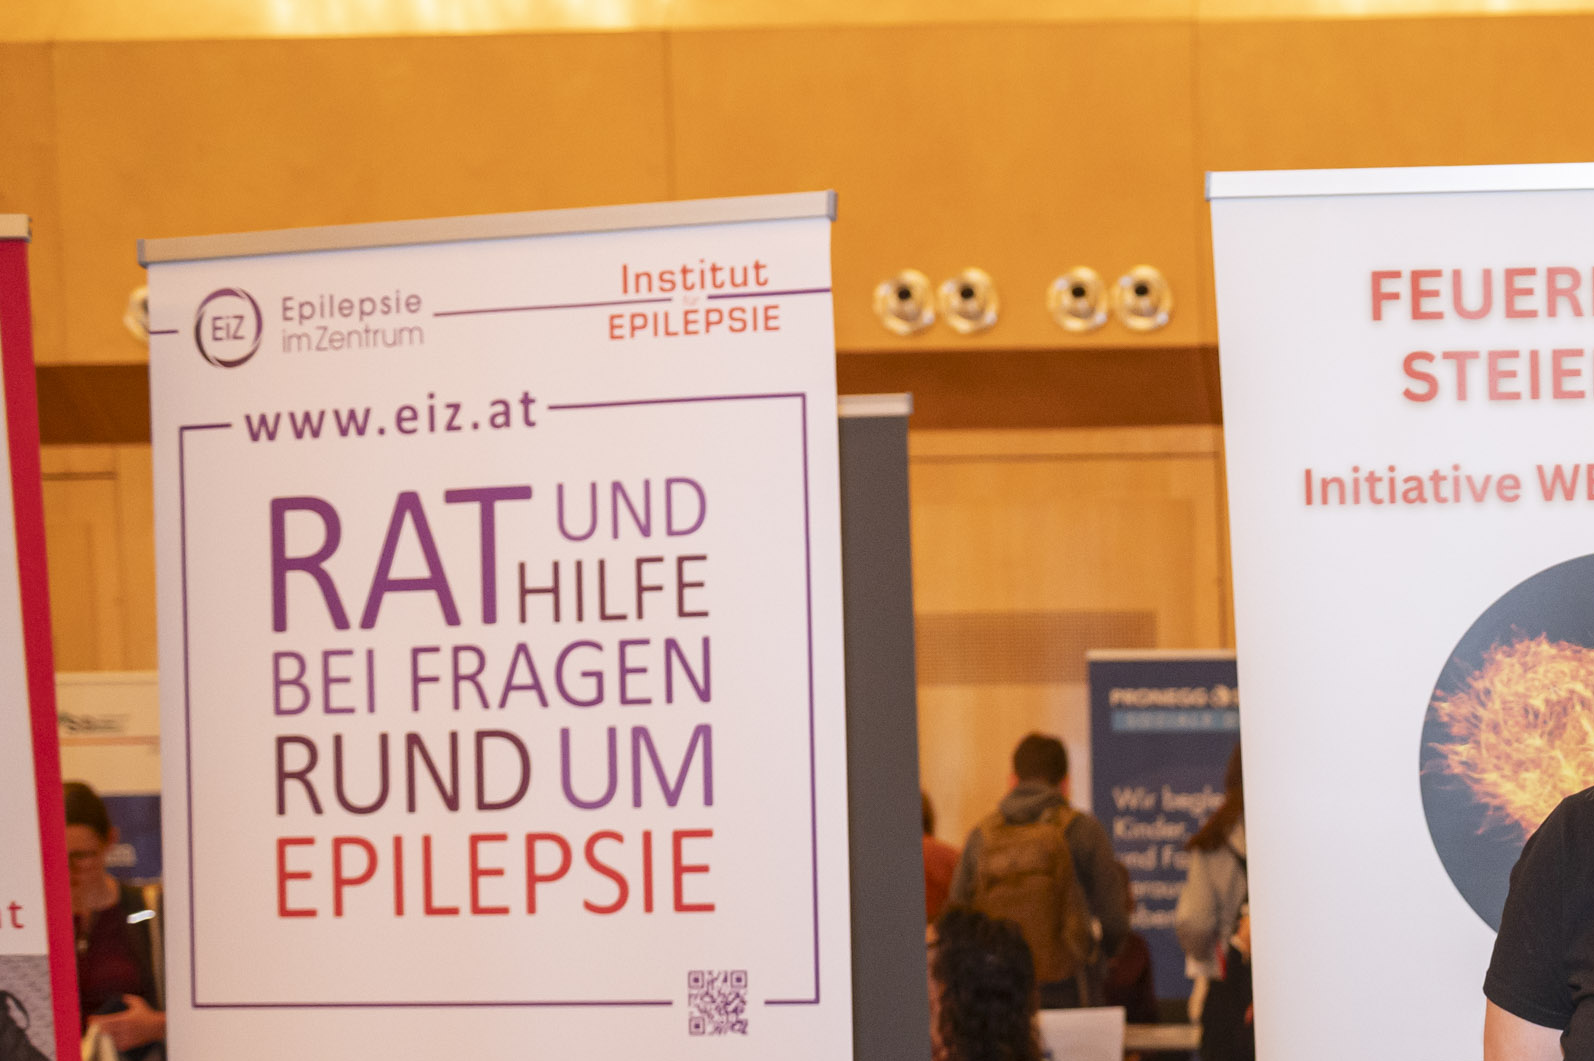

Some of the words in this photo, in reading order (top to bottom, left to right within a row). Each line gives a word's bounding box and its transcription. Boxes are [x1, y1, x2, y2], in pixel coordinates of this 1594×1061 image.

[621, 258, 770, 295] Institut
[211, 315, 246, 342] EiZ
[282, 289, 423, 325] Epilepsie
[608, 304, 781, 341] EPILEPSIE
[244, 390, 537, 442] www.eiz.at
[1303, 462, 1521, 507] Initiative
[269, 485, 533, 634] RAT
[556, 476, 707, 542] UND
[517, 554, 710, 625] HILFE
[273, 648, 375, 716] BEI
[410, 636, 713, 713] FRAGEN
[274, 728, 531, 816] RUND
[560, 723, 716, 809] UM
[277, 828, 717, 918] EPILEPSIE
